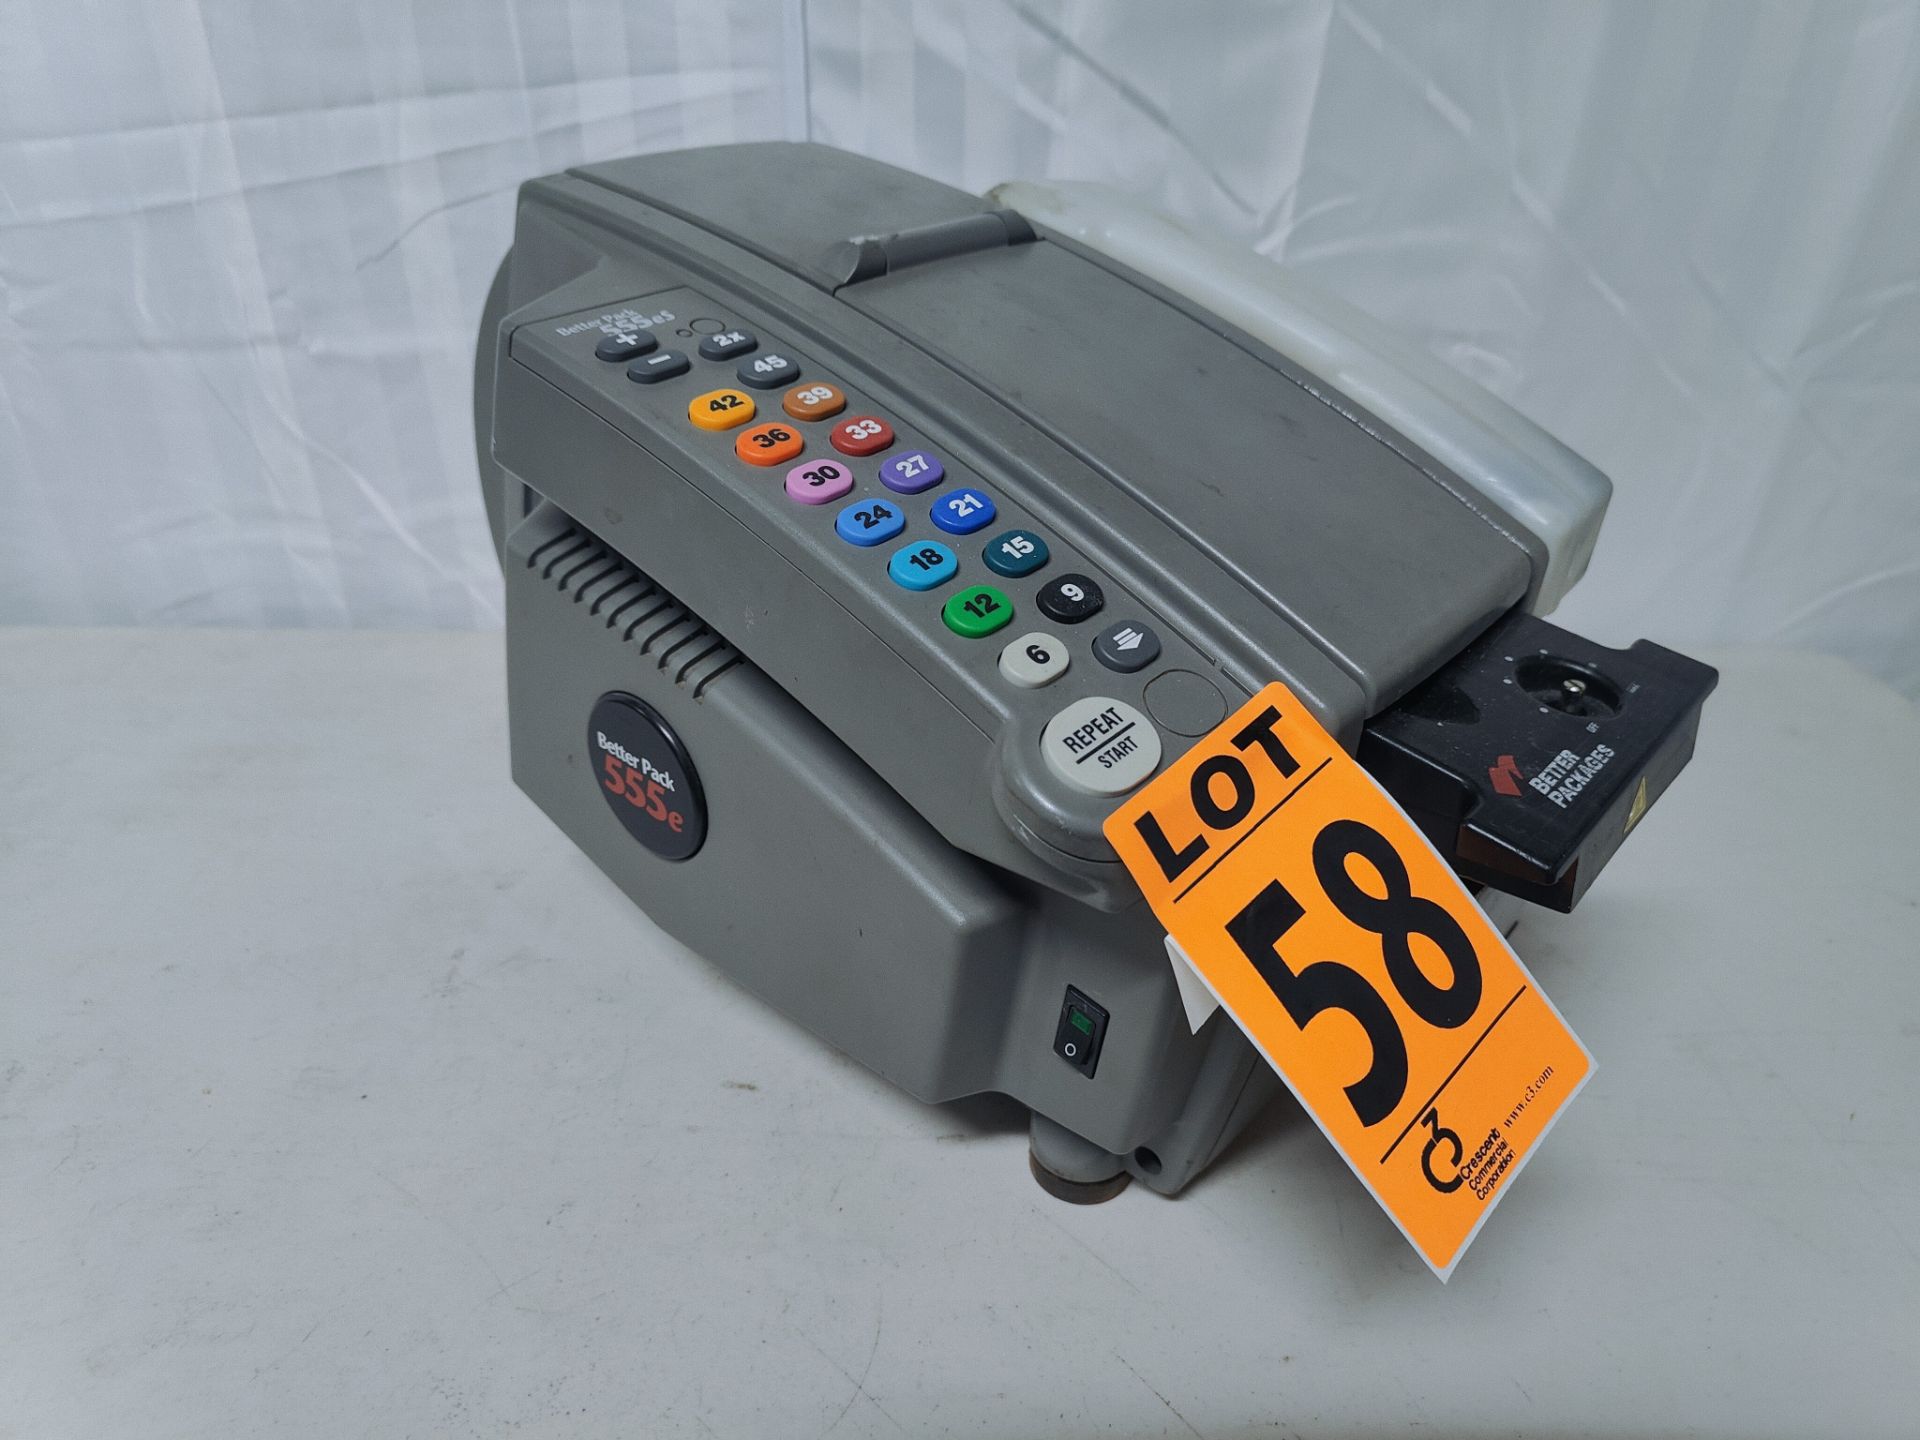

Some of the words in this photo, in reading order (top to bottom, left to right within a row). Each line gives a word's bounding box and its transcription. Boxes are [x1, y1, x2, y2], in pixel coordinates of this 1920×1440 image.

[555, 319, 602, 337] Better
[601, 309, 640, 324] Pack
[712, 331, 746, 347] 2x
[752, 354, 788, 374] 45
[708, 394, 744, 413] 42
[796, 386, 833, 405] 39
[752, 428, 790, 448] 36
[845, 419, 882, 440] 33
[802, 465, 840, 487] 30
[895, 454, 930, 478] 27
[854, 504, 893, 530] 24
[948, 492, 984, 517] 21
[909, 547, 944, 571] 18
[1001, 535, 1035, 560] 15
[963, 592, 1000, 618] 12
[1060, 583, 1085, 602] 9
[1026, 644, 1051, 665] 6
[1062, 706, 1126, 754] REPEAT
[596, 731, 640, 769] Better
[641, 757, 676, 792] Pack
[1097, 735, 1139, 769] START
[1528, 749, 1581, 795] BETTER
[1547, 743, 1615, 808] PACKAGES
[604, 753, 684, 833] 555e
[1134, 705, 1301, 884] LOT
[1224, 819, 1483, 1128] 58
[1503, 1065, 1554, 1128] www.c3.com
[1459, 1127, 1501, 1180] Crescent
[1468, 1137, 1510, 1191] Commercial
[1476, 1149, 1517, 1201] Corporation
